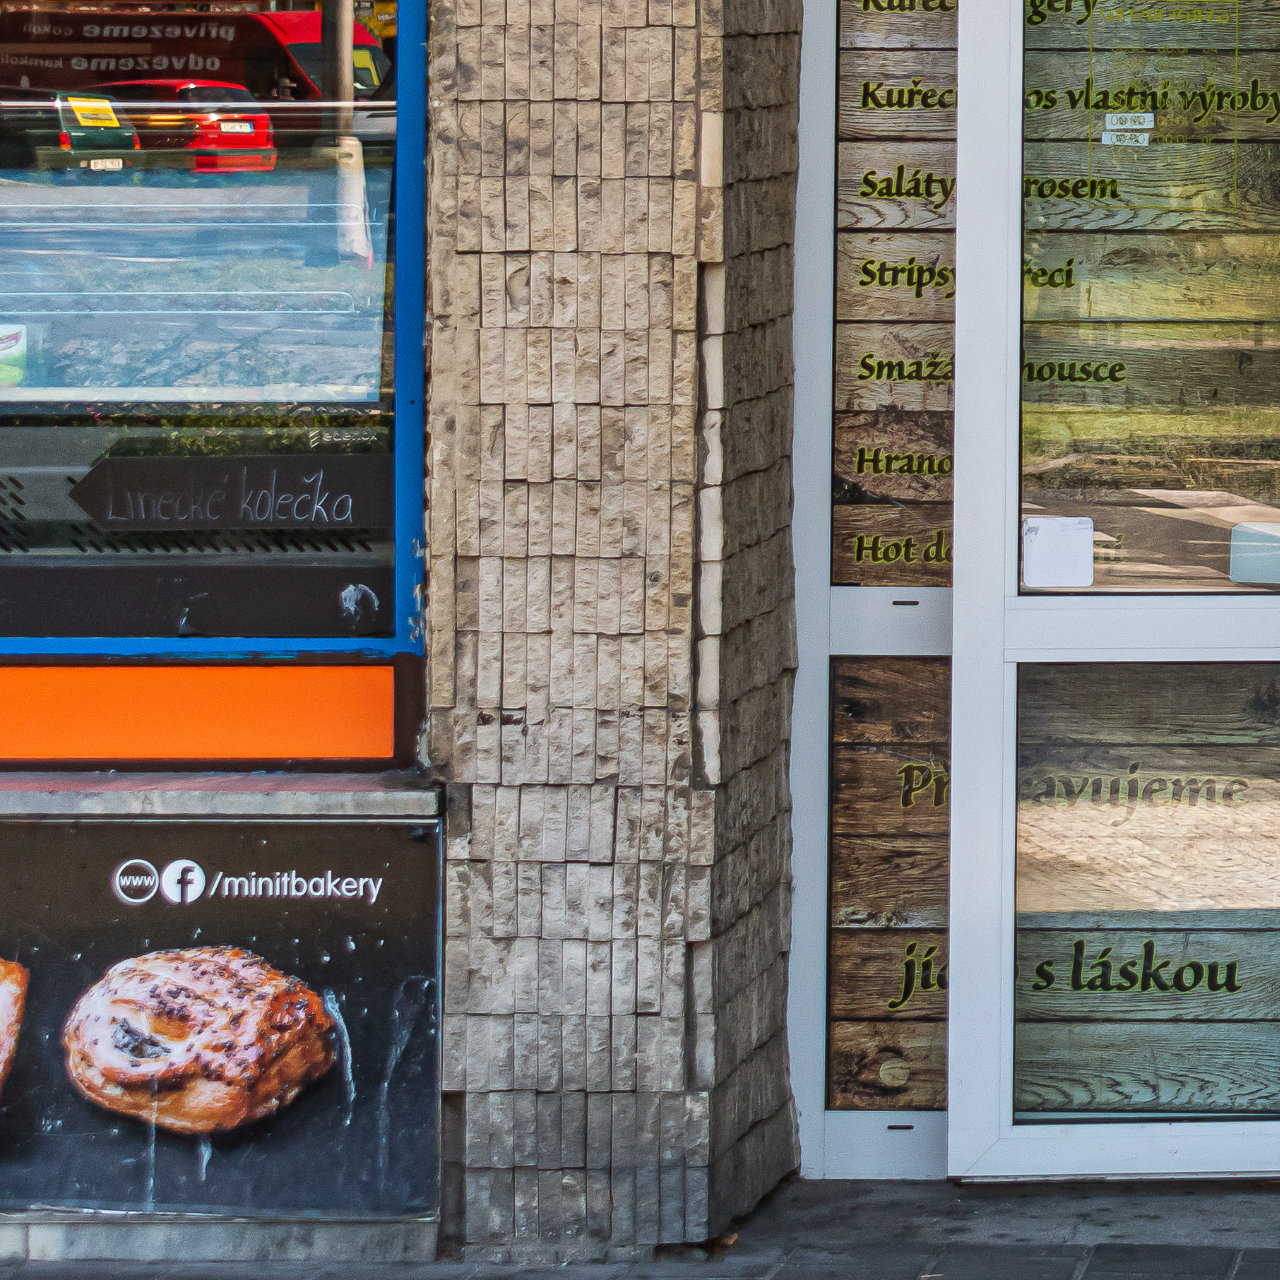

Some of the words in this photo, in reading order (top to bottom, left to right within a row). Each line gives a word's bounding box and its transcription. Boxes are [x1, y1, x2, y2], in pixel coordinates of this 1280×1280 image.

[859, 163, 957, 210] Saláty
[1024, 176, 1121, 199] rosem
[856, 447, 953, 475] Hrano
[239, 466, 353, 523] kolečka
[855, 534, 918, 564] Hot
[1032, 959, 1056, 991] s
[1071, 938, 1243, 993] láskou
